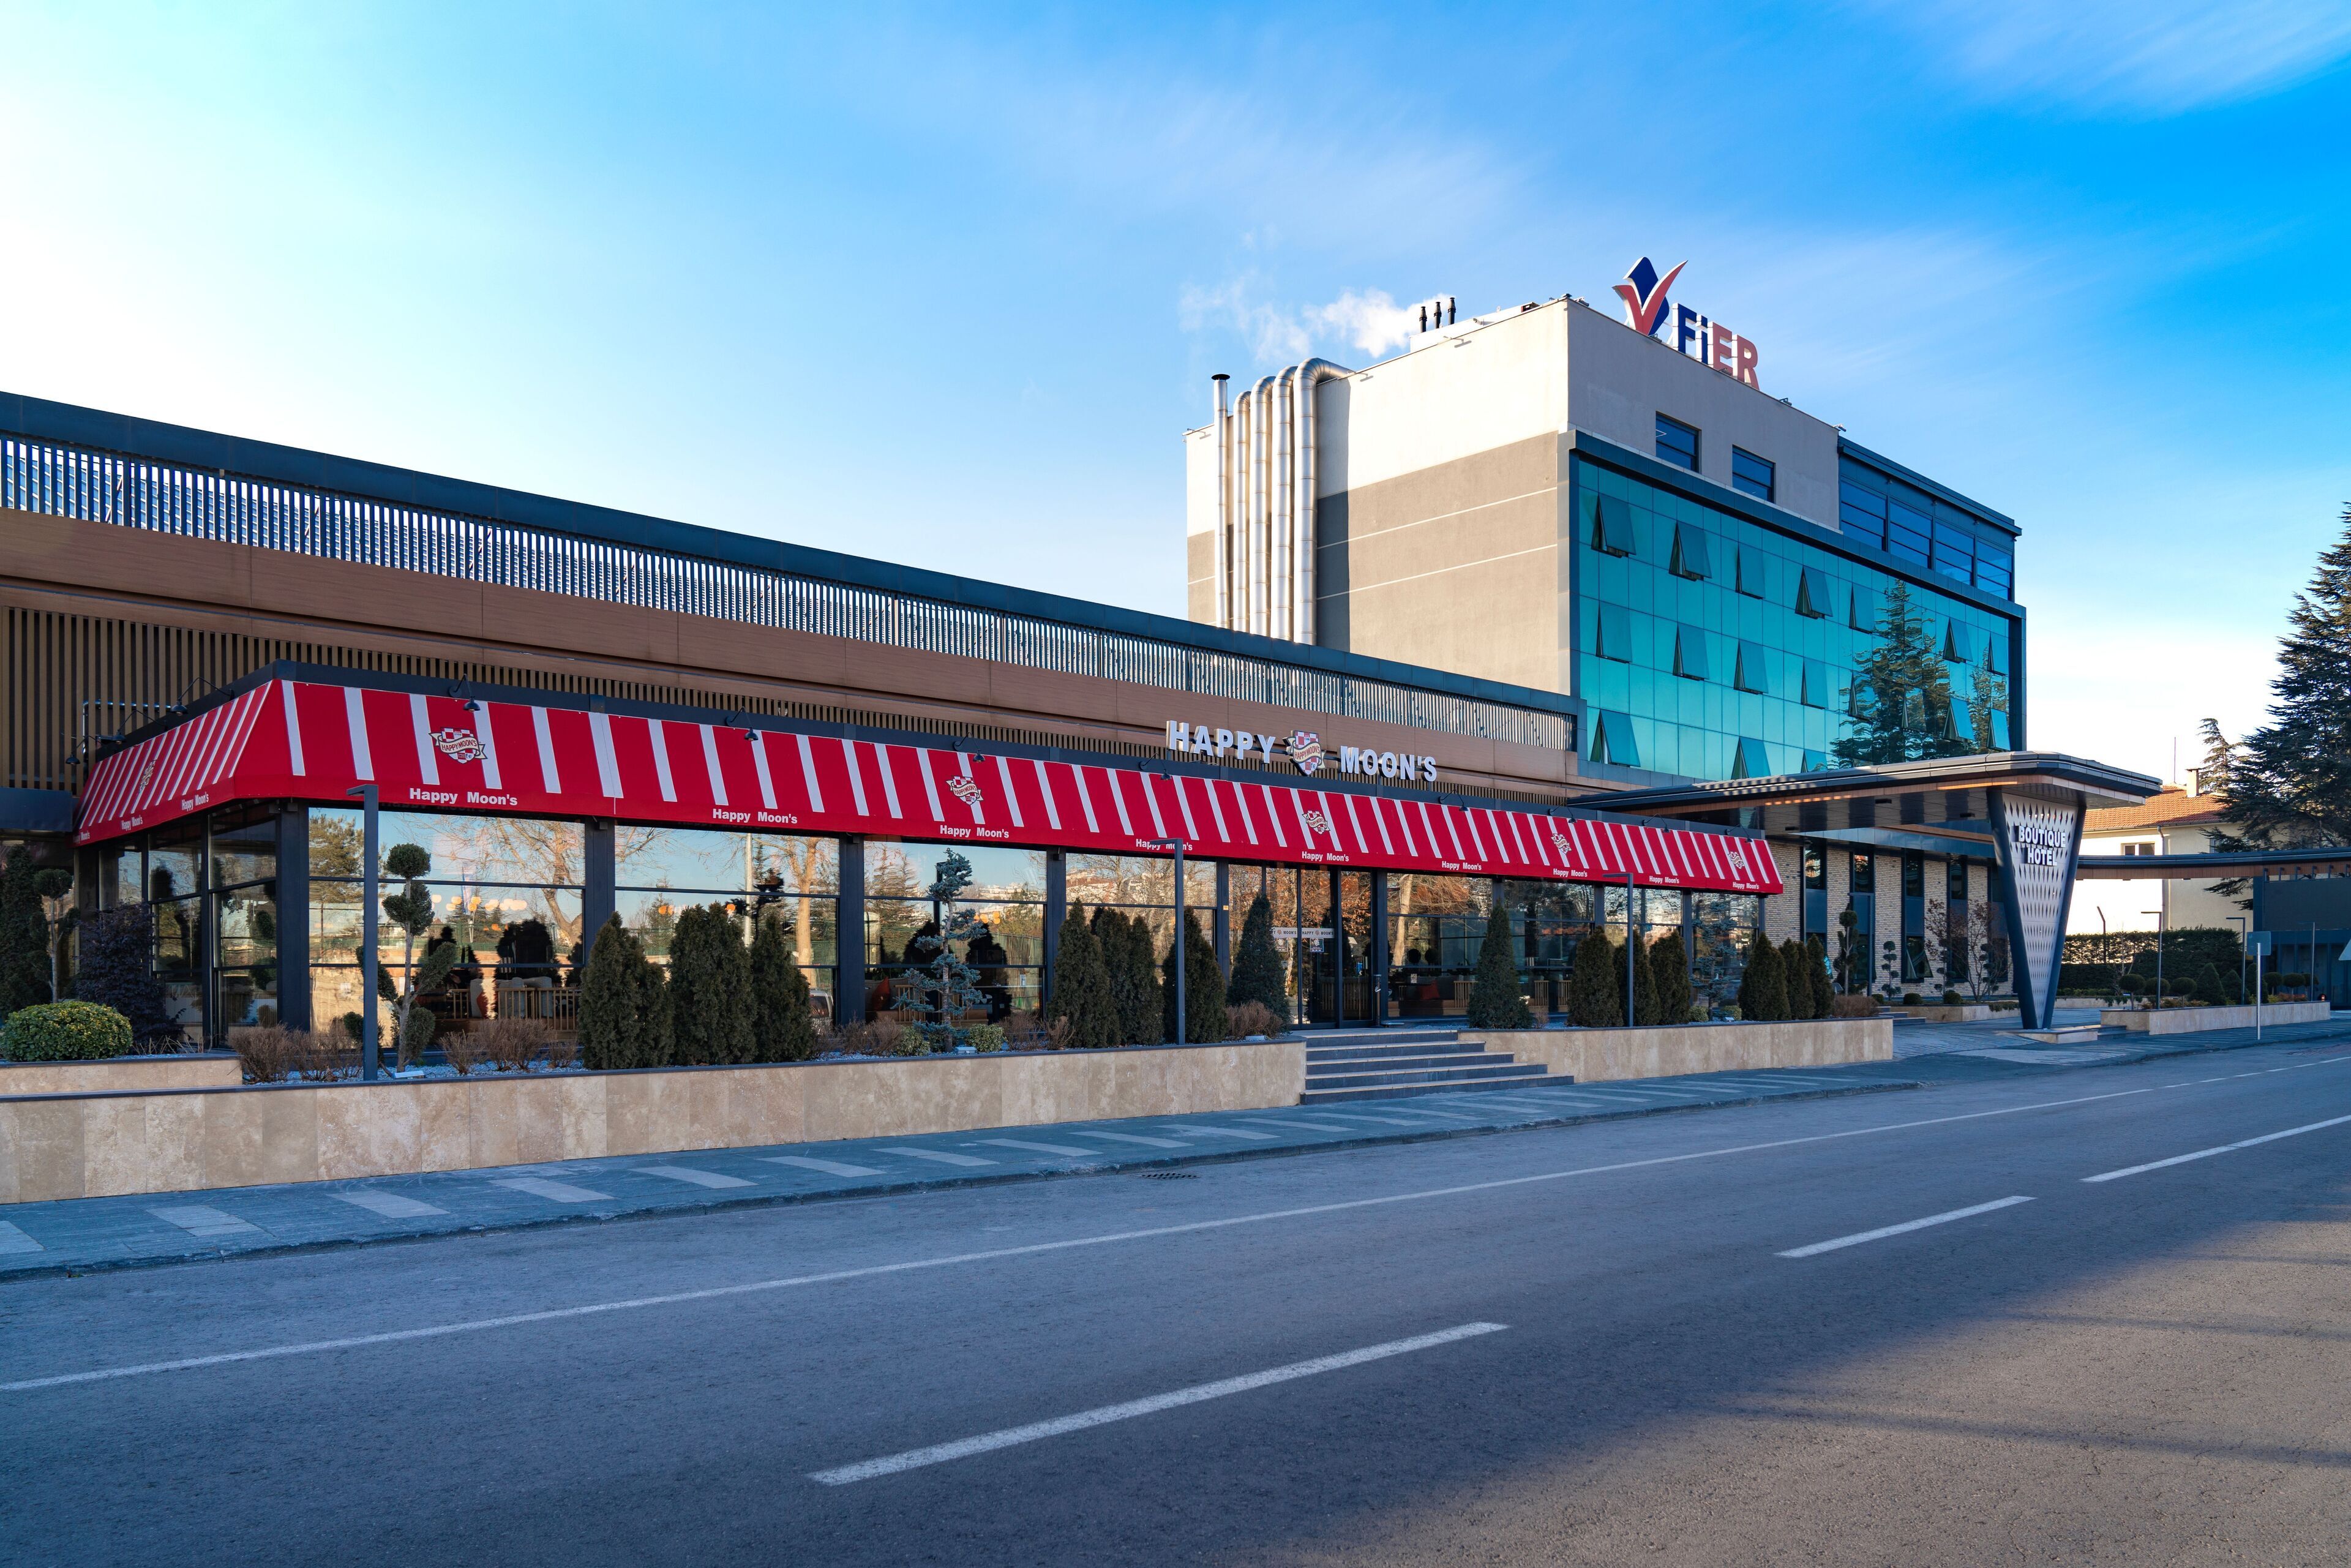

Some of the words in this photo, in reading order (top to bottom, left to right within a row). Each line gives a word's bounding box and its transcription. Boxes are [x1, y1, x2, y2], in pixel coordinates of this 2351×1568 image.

[1167, 720, 1276, 763] HAPPY
[1340, 745, 1438, 782] MOON'S
[182, 799, 193, 812] Happy
[195, 792, 209, 806] Moon's
[409, 787, 458, 804] Happy
[467, 792, 518, 806] Moon's
[713, 808, 751, 823] Happy
[758, 811, 798, 824] Moon's
[122, 820, 131, 831] Happy
[940, 825, 971, 838] Happy
[977, 827, 1010, 838] Moon's
[2018, 825, 2066, 848] BOUTIQUE
[1302, 851, 1323, 862] Happy
[1327, 853, 1349, 862] Moon's
[2027, 847, 2058, 866] HOTEL
[1442, 861, 1460, 870] Happy
[1553, 868, 1569, 877] Happy
[1649, 876, 1663, 884] Happy
